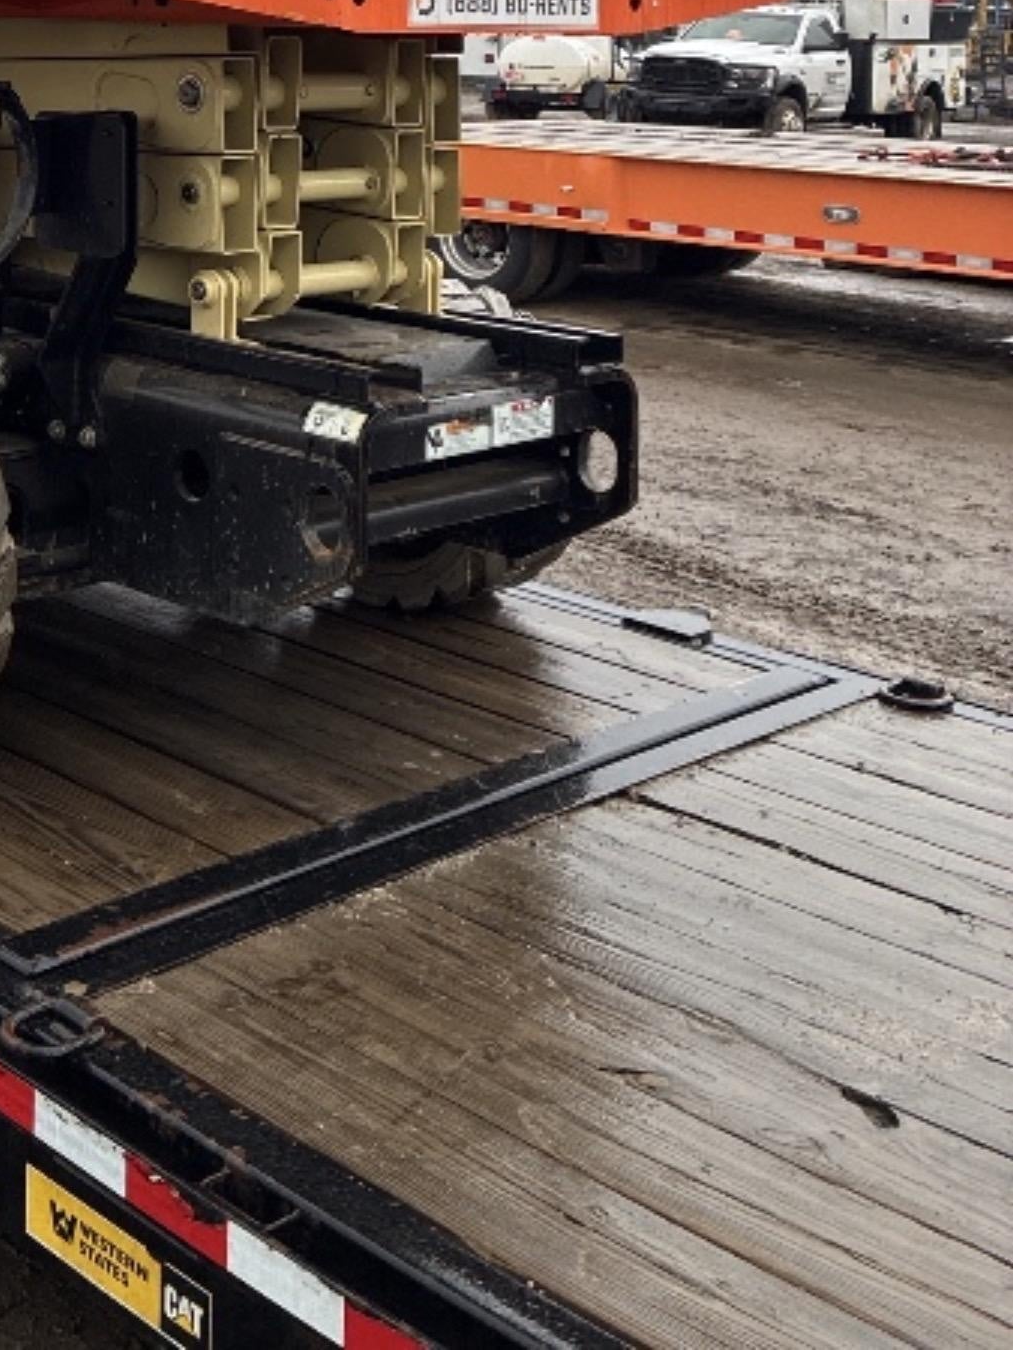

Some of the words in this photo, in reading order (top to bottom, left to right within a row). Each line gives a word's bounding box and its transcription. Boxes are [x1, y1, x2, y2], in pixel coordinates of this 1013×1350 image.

[79, 1217, 150, 1283] WESTERN
[79, 1239, 130, 1288] STATES
[163, 1283, 205, 1340] CAT
